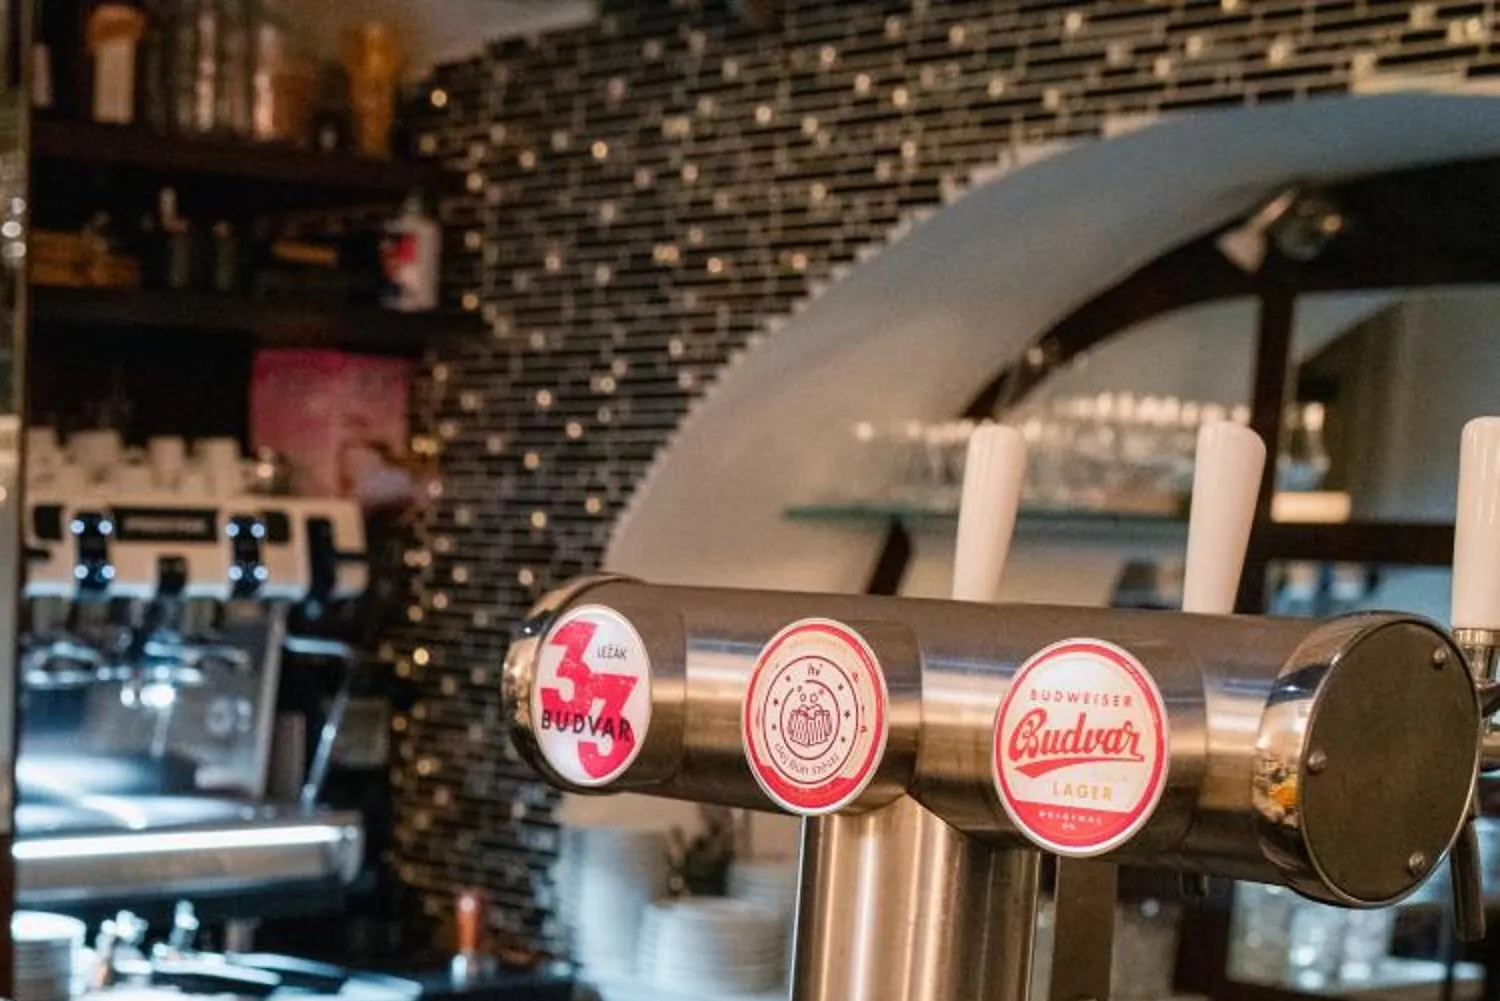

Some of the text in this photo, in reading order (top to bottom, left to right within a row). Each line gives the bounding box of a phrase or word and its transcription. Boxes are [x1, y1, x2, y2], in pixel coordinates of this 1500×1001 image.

[597, 643, 628, 662] LEŽÁK
[1029, 688, 1133, 708] BUDWEISER
[541, 709, 635, 743] BUDVAR
[1008, 707, 1145, 764] Budvar
[1051, 780, 1114, 801] LAGER
